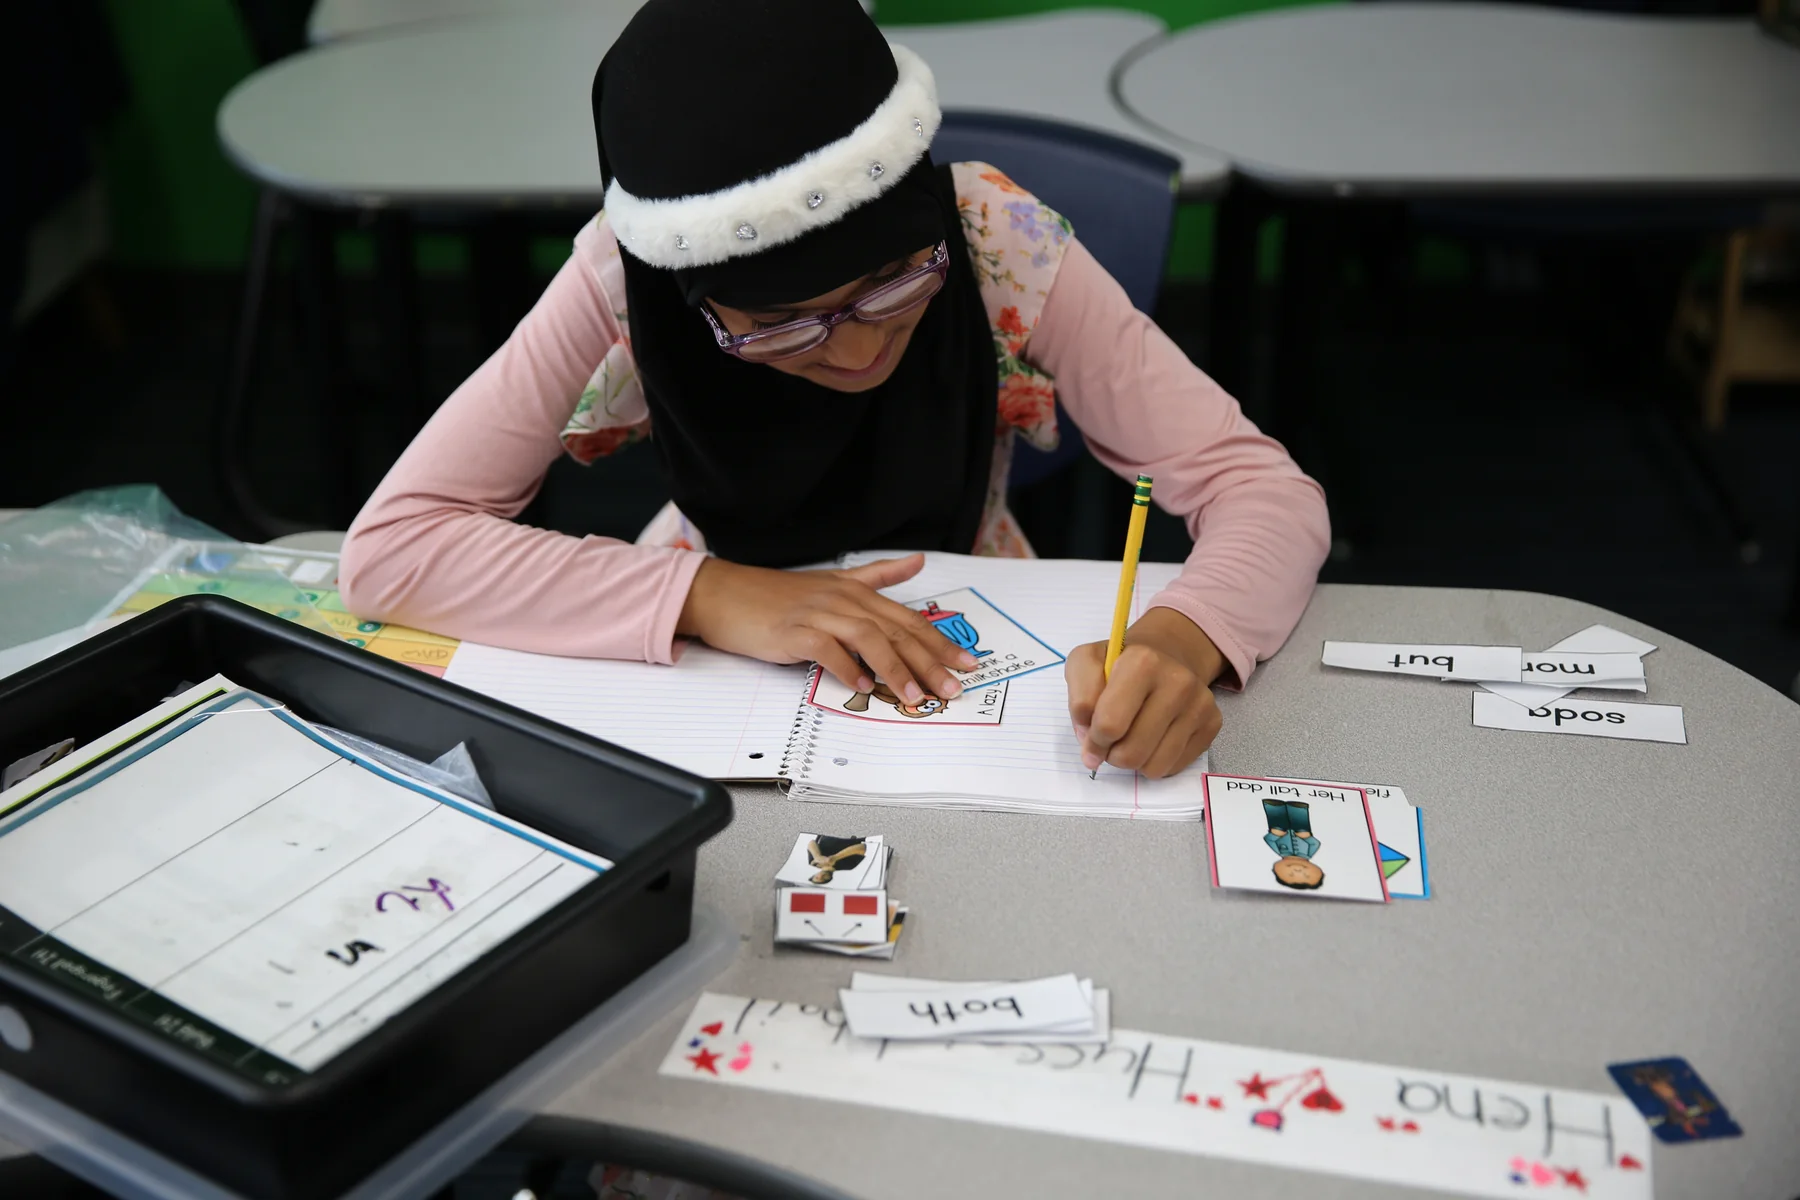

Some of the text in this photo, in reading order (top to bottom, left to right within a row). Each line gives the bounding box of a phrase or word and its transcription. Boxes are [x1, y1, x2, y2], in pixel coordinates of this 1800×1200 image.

[957, 653, 1018, 675] ank a
[961, 659, 1035, 686] milkshake
[1388, 654, 1454, 673] but
[1522, 661, 1595, 675] mor
[977, 688, 1002, 716] A lazy
[1529, 707, 1626, 726] soda
[1227, 781, 1345, 802] Her tall dad
[1365, 787, 1391, 798] fle
[910, 996, 1024, 1026] both
[1397, 1077, 1615, 1169] Hena
